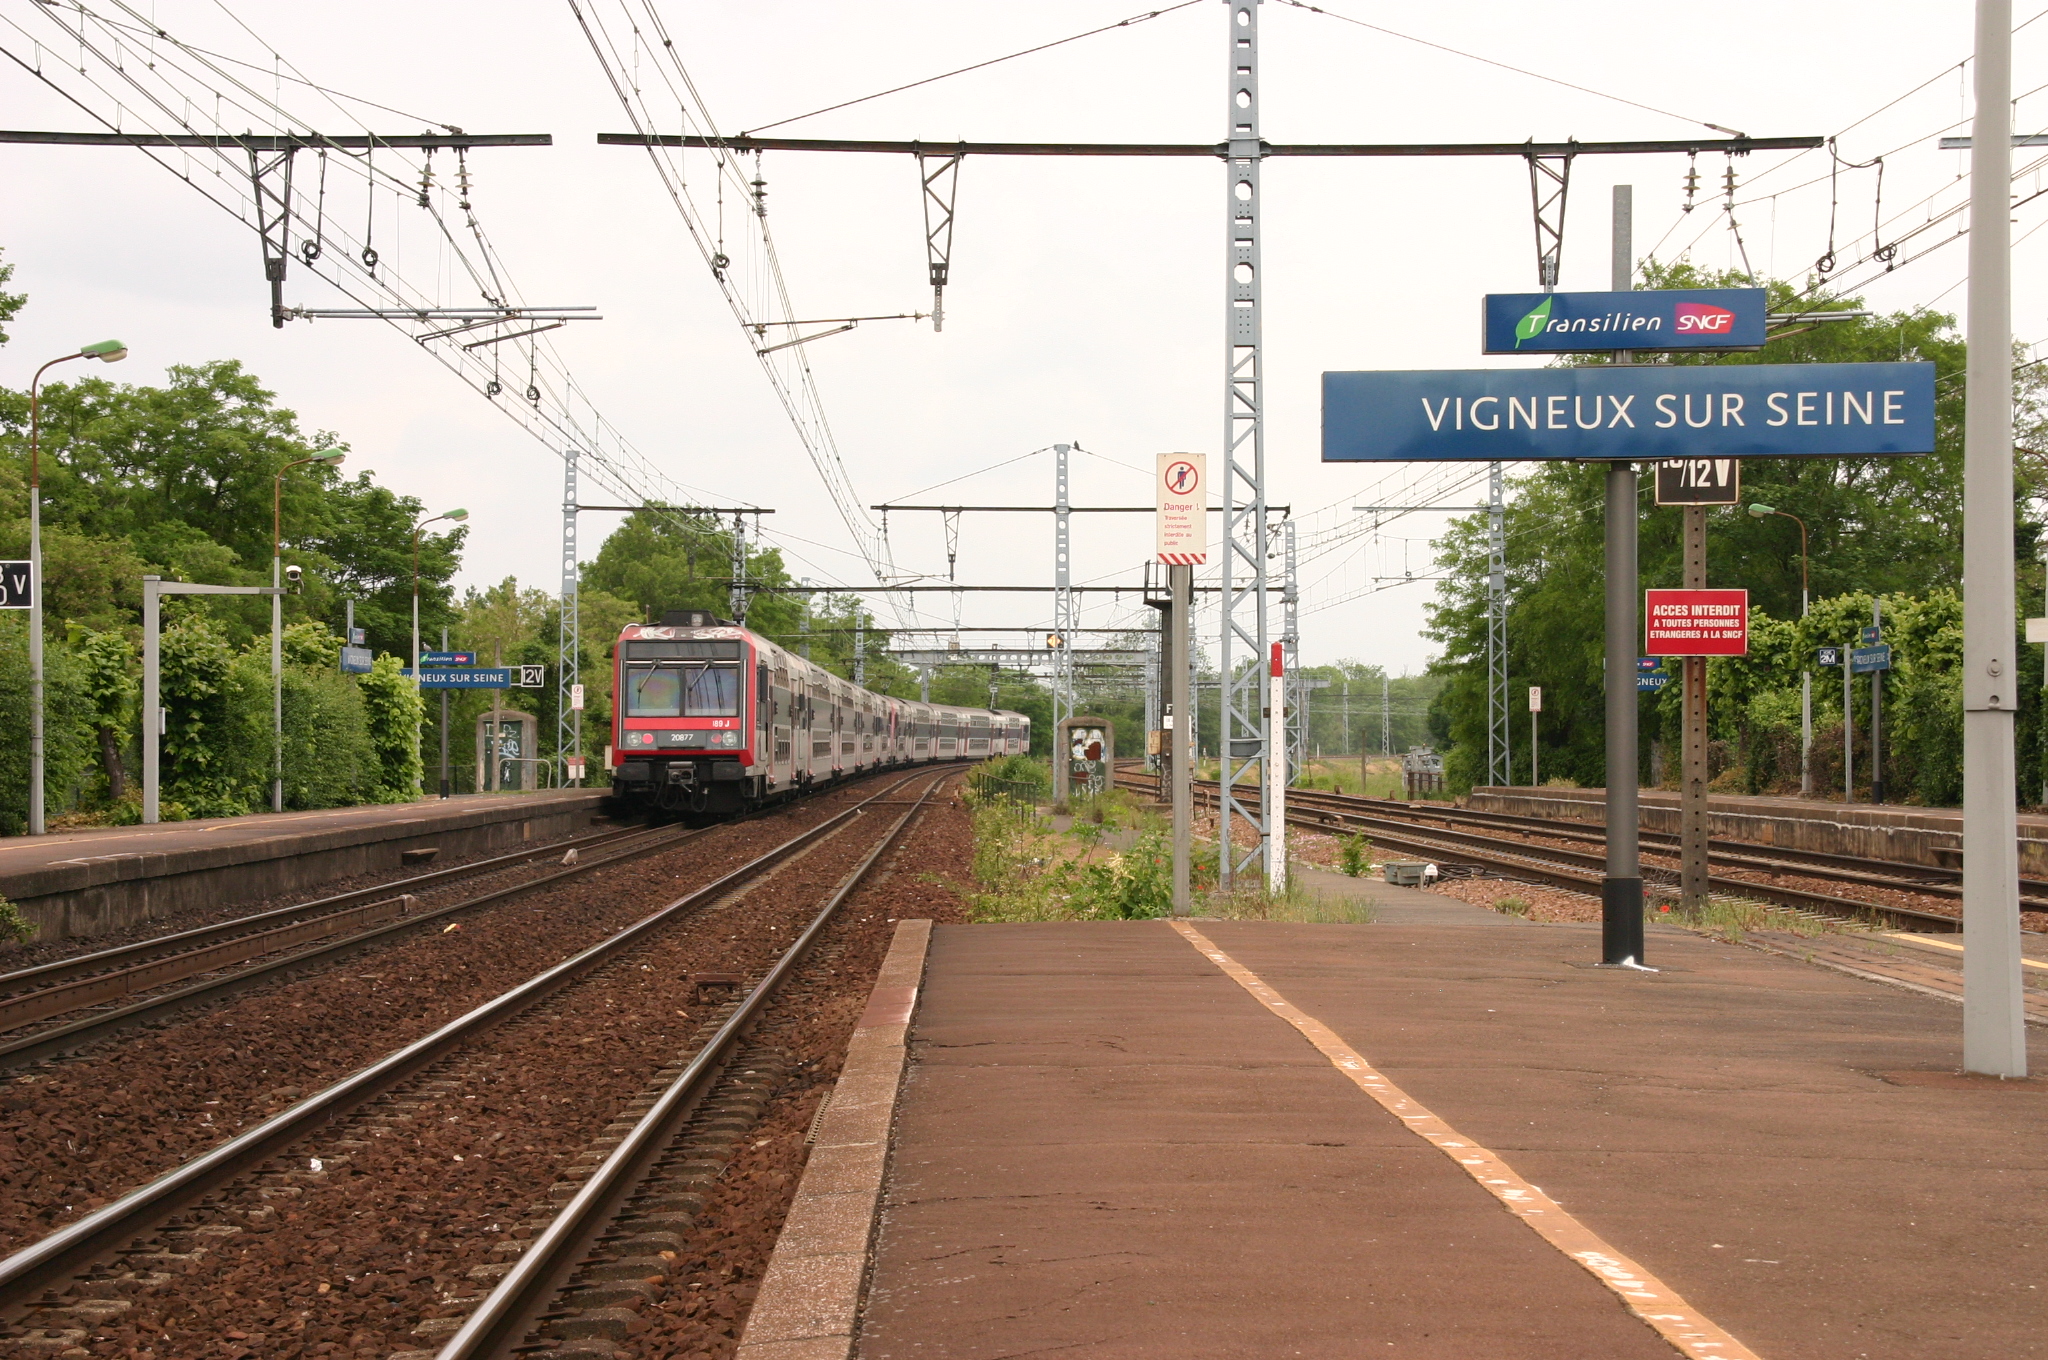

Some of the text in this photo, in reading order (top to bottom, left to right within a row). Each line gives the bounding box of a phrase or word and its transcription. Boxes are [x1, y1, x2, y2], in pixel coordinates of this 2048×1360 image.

[1528, 312, 1731, 333] Transilien SNCF
[1421, 390, 1906, 431] VIGNEUX SUR SEINE
[1163, 502, 1193, 512] Danger
[1652, 604, 1741, 616] ACCES INTERDIT
[1653, 619, 1740, 628] A TOUTES PERSONNES
[1649, 630, 1743, 639] ETRANGERES A LA SNCF
[449, 673, 470, 683] SUR
[473, 673, 504, 683] SEINE
[523, 669, 542, 684] 12V
[670, 733, 694, 741] 20877
